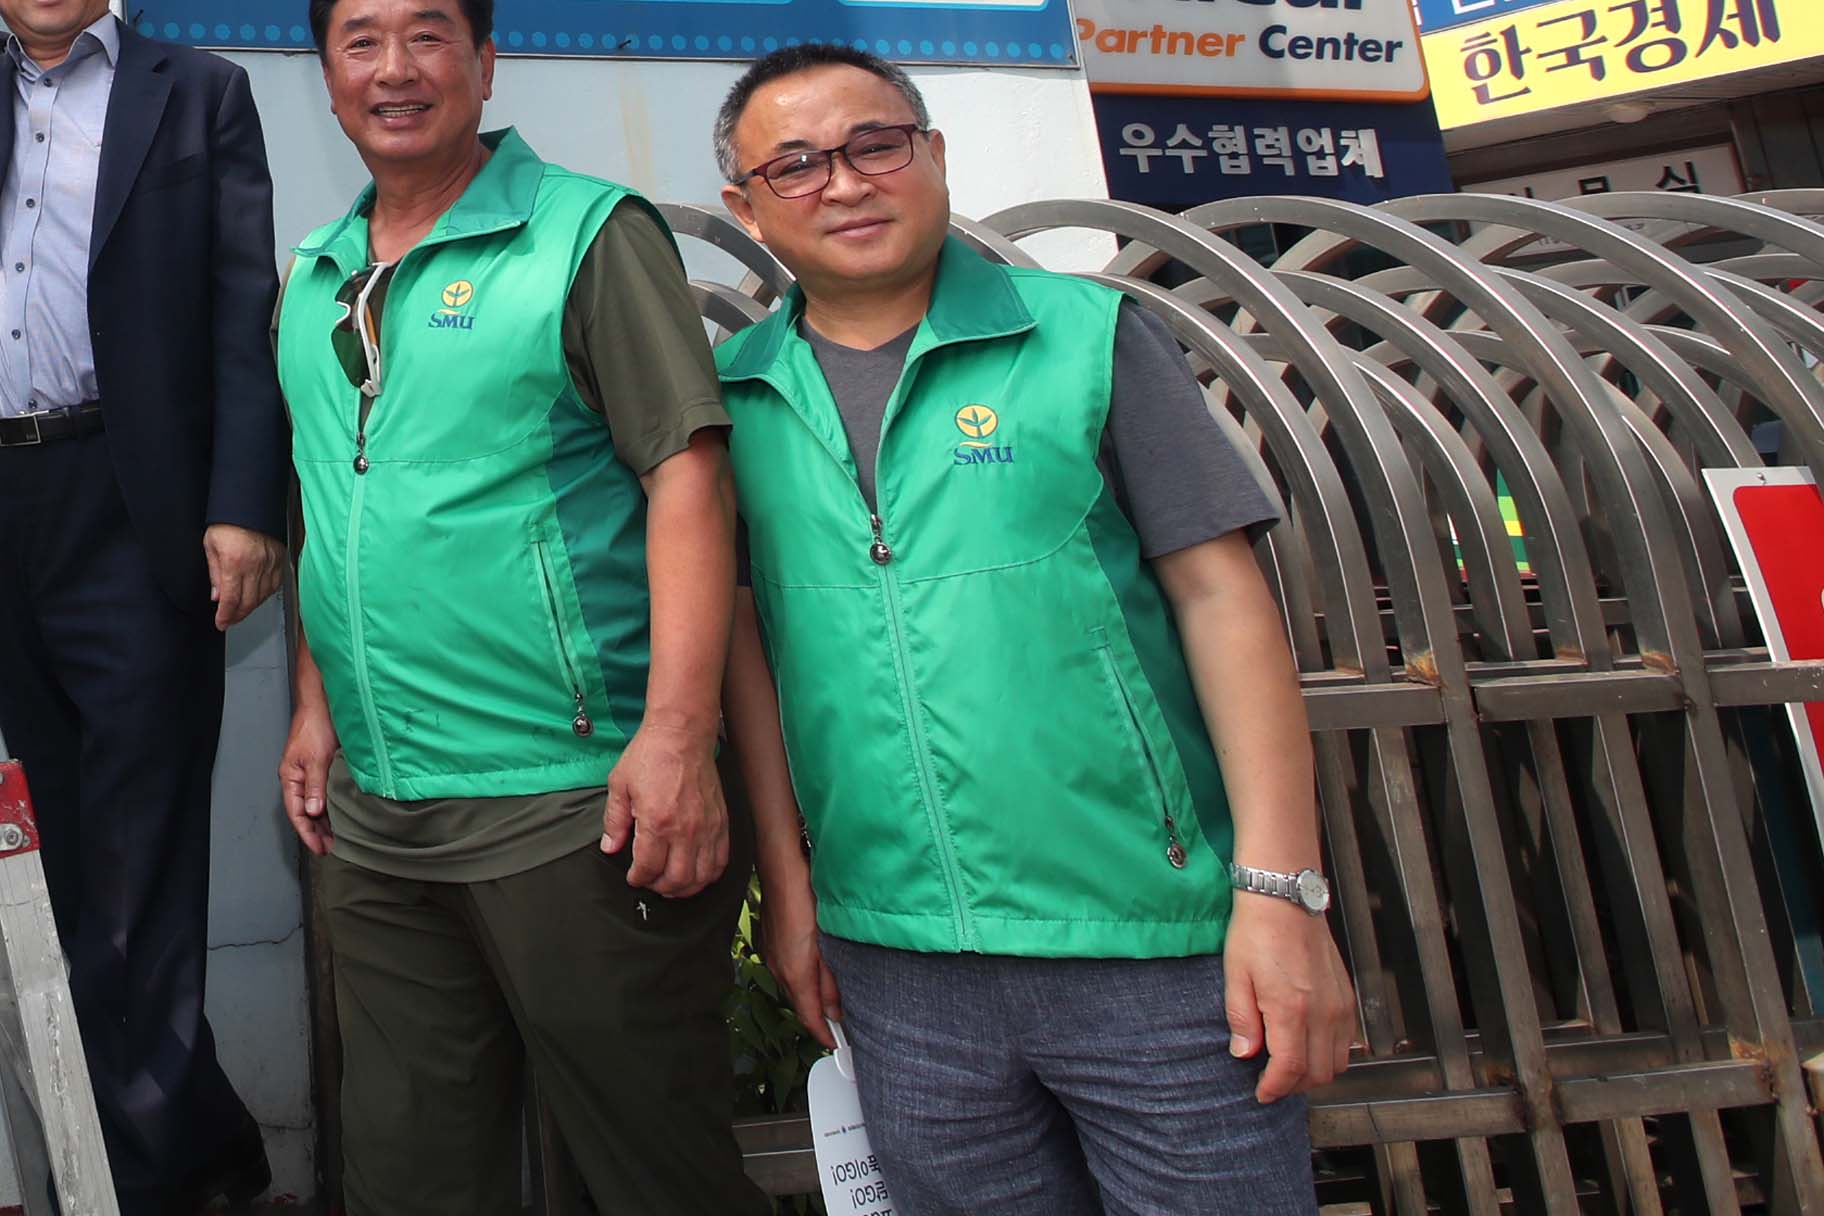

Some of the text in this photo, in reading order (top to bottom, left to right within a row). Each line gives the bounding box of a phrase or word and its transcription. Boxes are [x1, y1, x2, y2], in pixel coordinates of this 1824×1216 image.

[1075, 18, 1403, 63] Partner Center
[1120, 123, 1385, 178] 우수협력업체
[428, 313, 475, 329] SMU
[953, 446, 1013, 464] SMU
